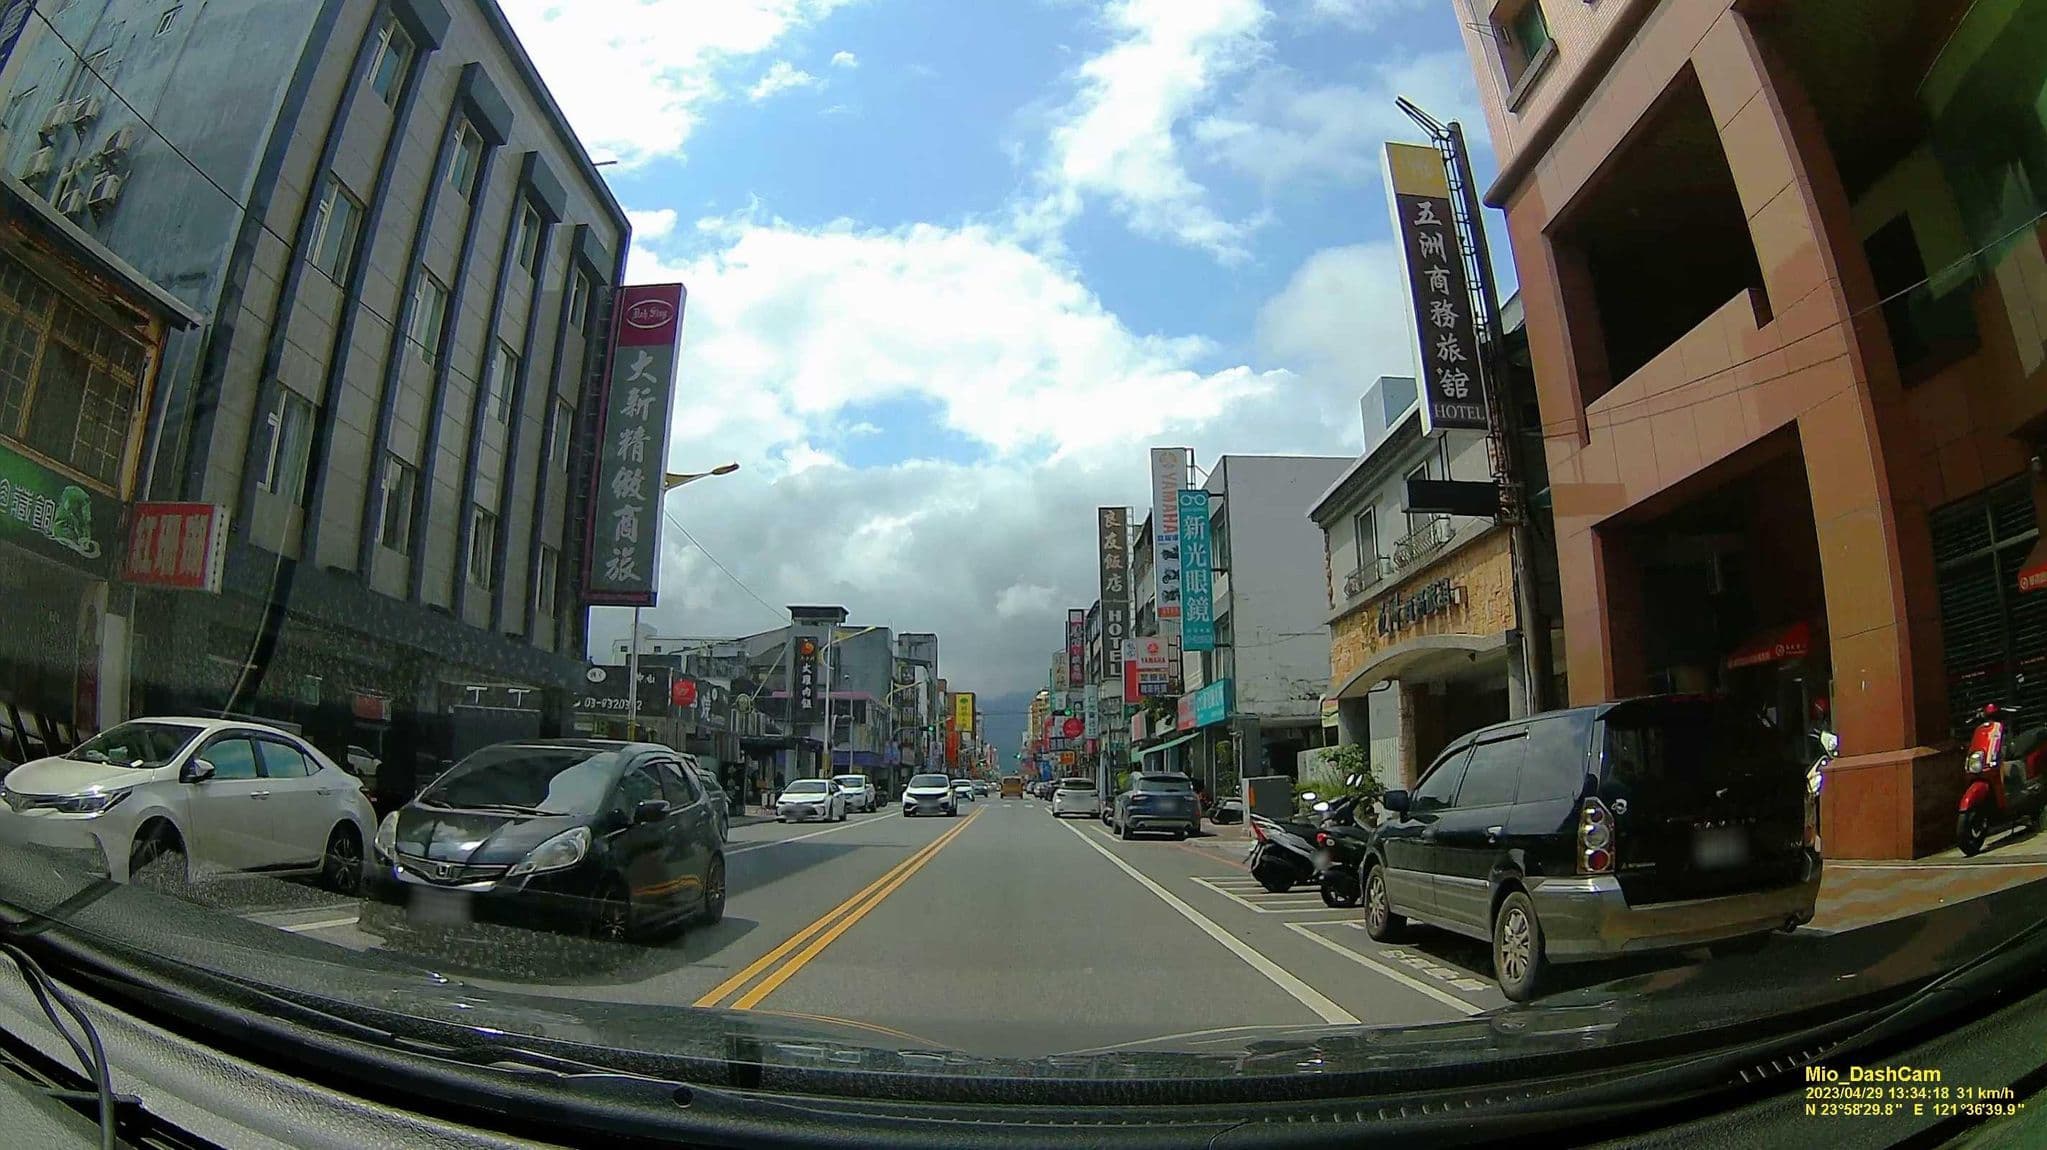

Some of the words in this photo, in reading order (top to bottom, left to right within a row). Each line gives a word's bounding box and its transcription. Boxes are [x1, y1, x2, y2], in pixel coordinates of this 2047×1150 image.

[1434, 404, 1486, 421] HOTEL
[605, 350, 658, 583] 大新精緻商旅
[1162, 472, 1178, 534] YAMAHA
[1103, 510, 1124, 593] 良友飯店
[1183, 514, 1210, 622] 新光眼鏡
[1108, 610, 1123, 676] HOTEL
[1140, 655, 1167, 664] YAMAHA
[584, 697, 643, 710] 03-832032
